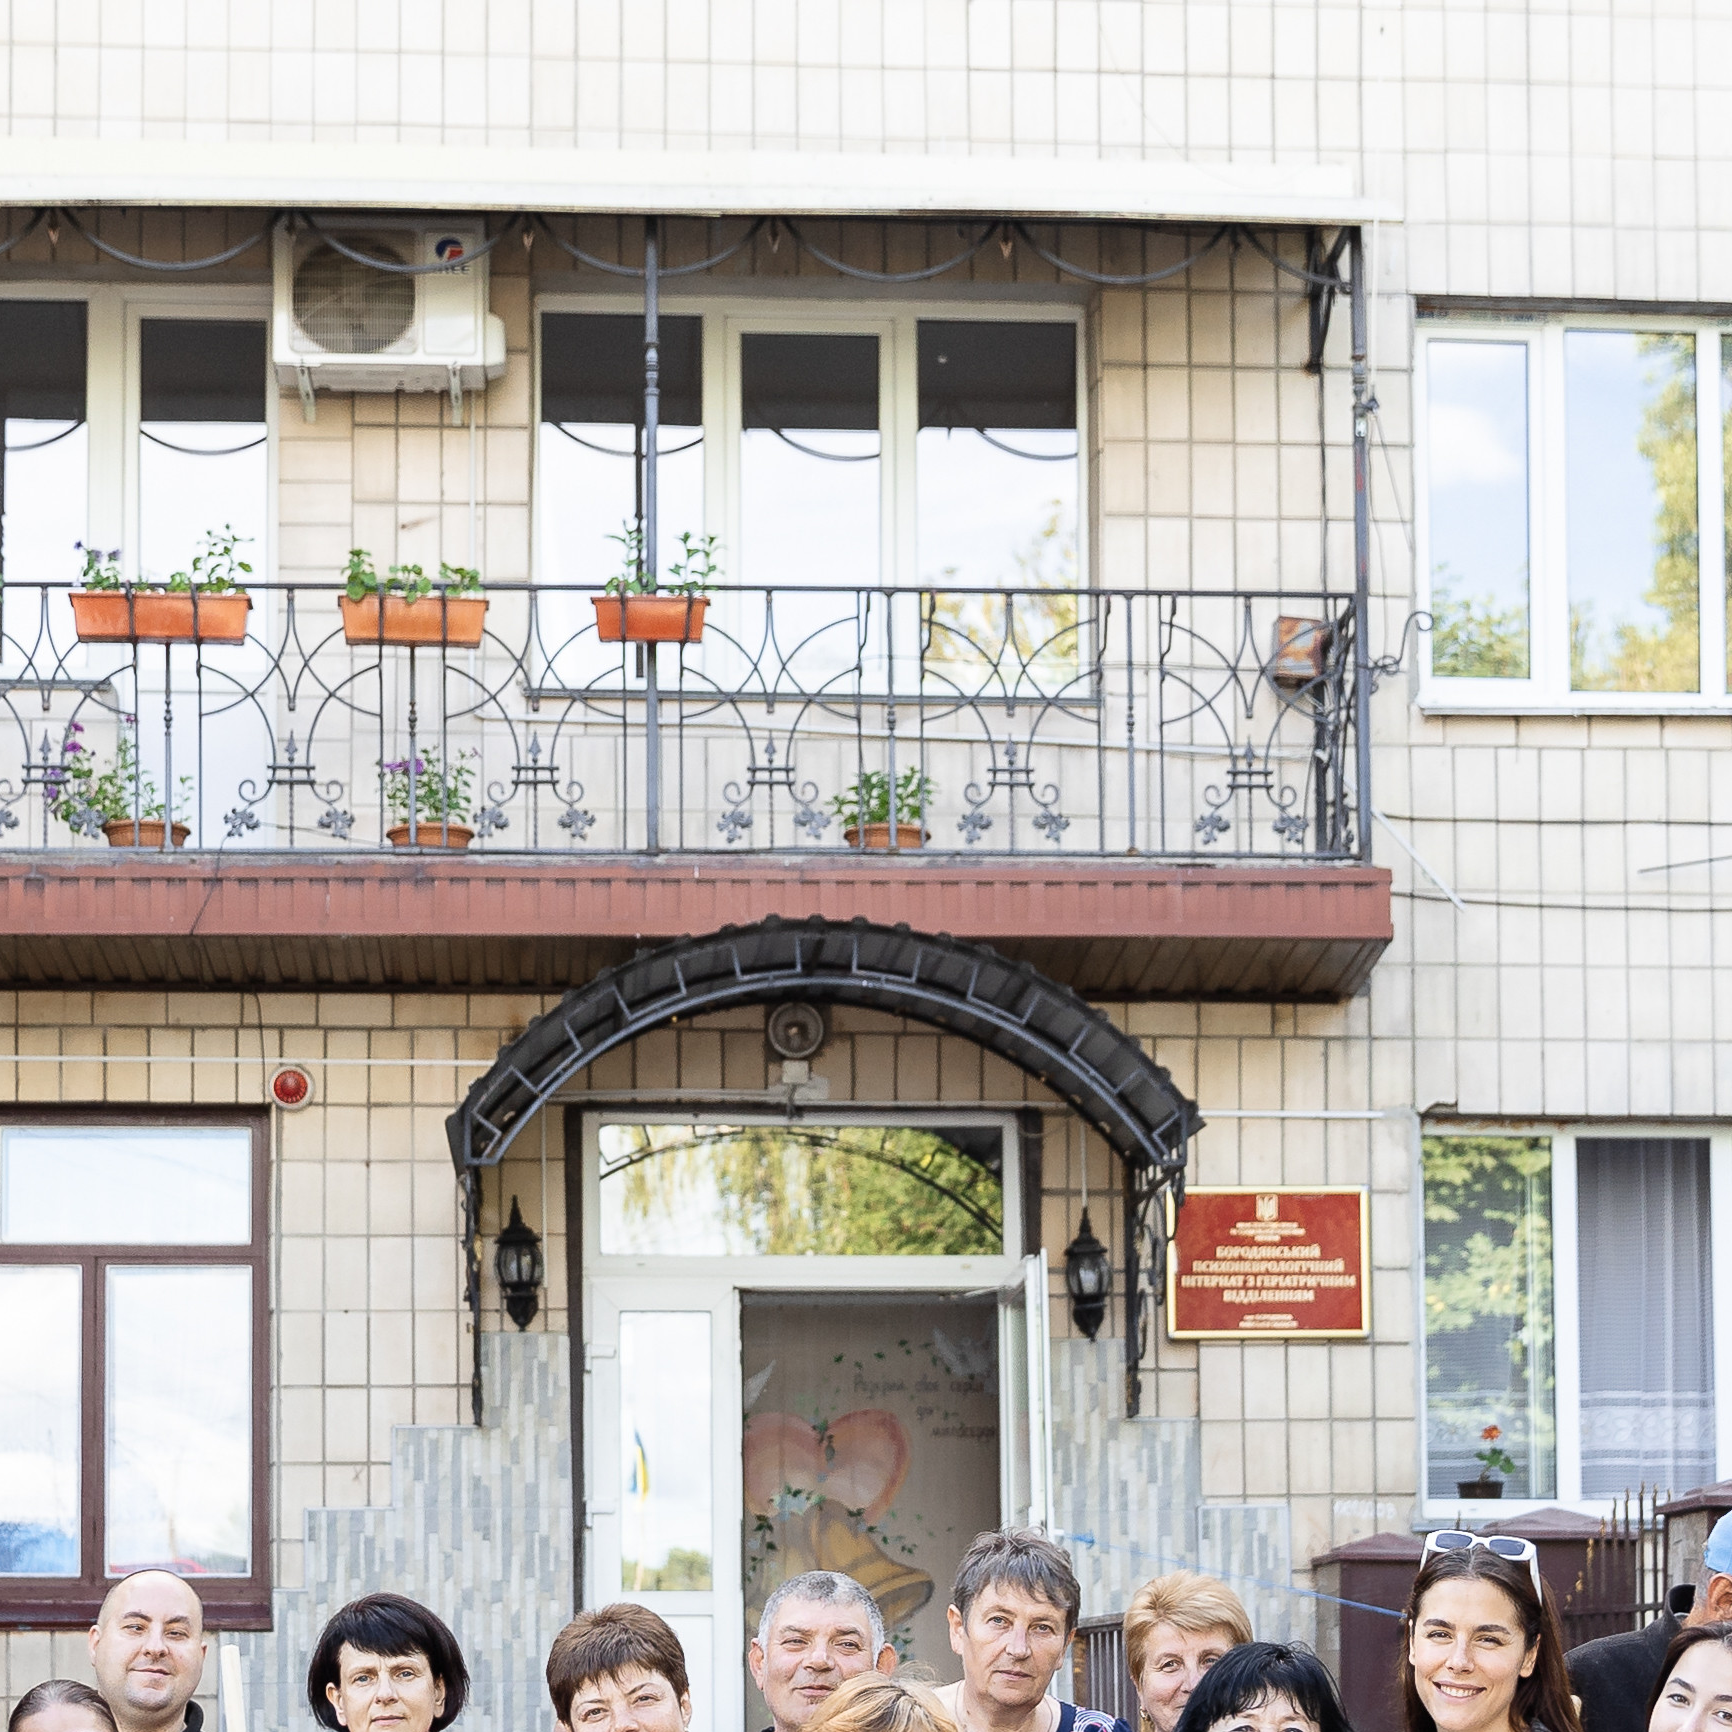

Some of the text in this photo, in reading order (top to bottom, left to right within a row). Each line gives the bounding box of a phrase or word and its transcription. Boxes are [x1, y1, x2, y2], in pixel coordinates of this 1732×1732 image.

[1215, 1243, 1321, 1259] БОРОДЯНСЬКИЙ
[1192, 1258, 1345, 1273] ПСИХОНЕВРОЛОГІЧНИЙ
[1181, 1275, 1244, 1288] ІНТЕРНАТ
[1256, 1275, 1357, 1288] ГЕРІАТРИЧНИМ
[1222, 1289, 1315, 1304] ВІДДІЛЕННЯМ
